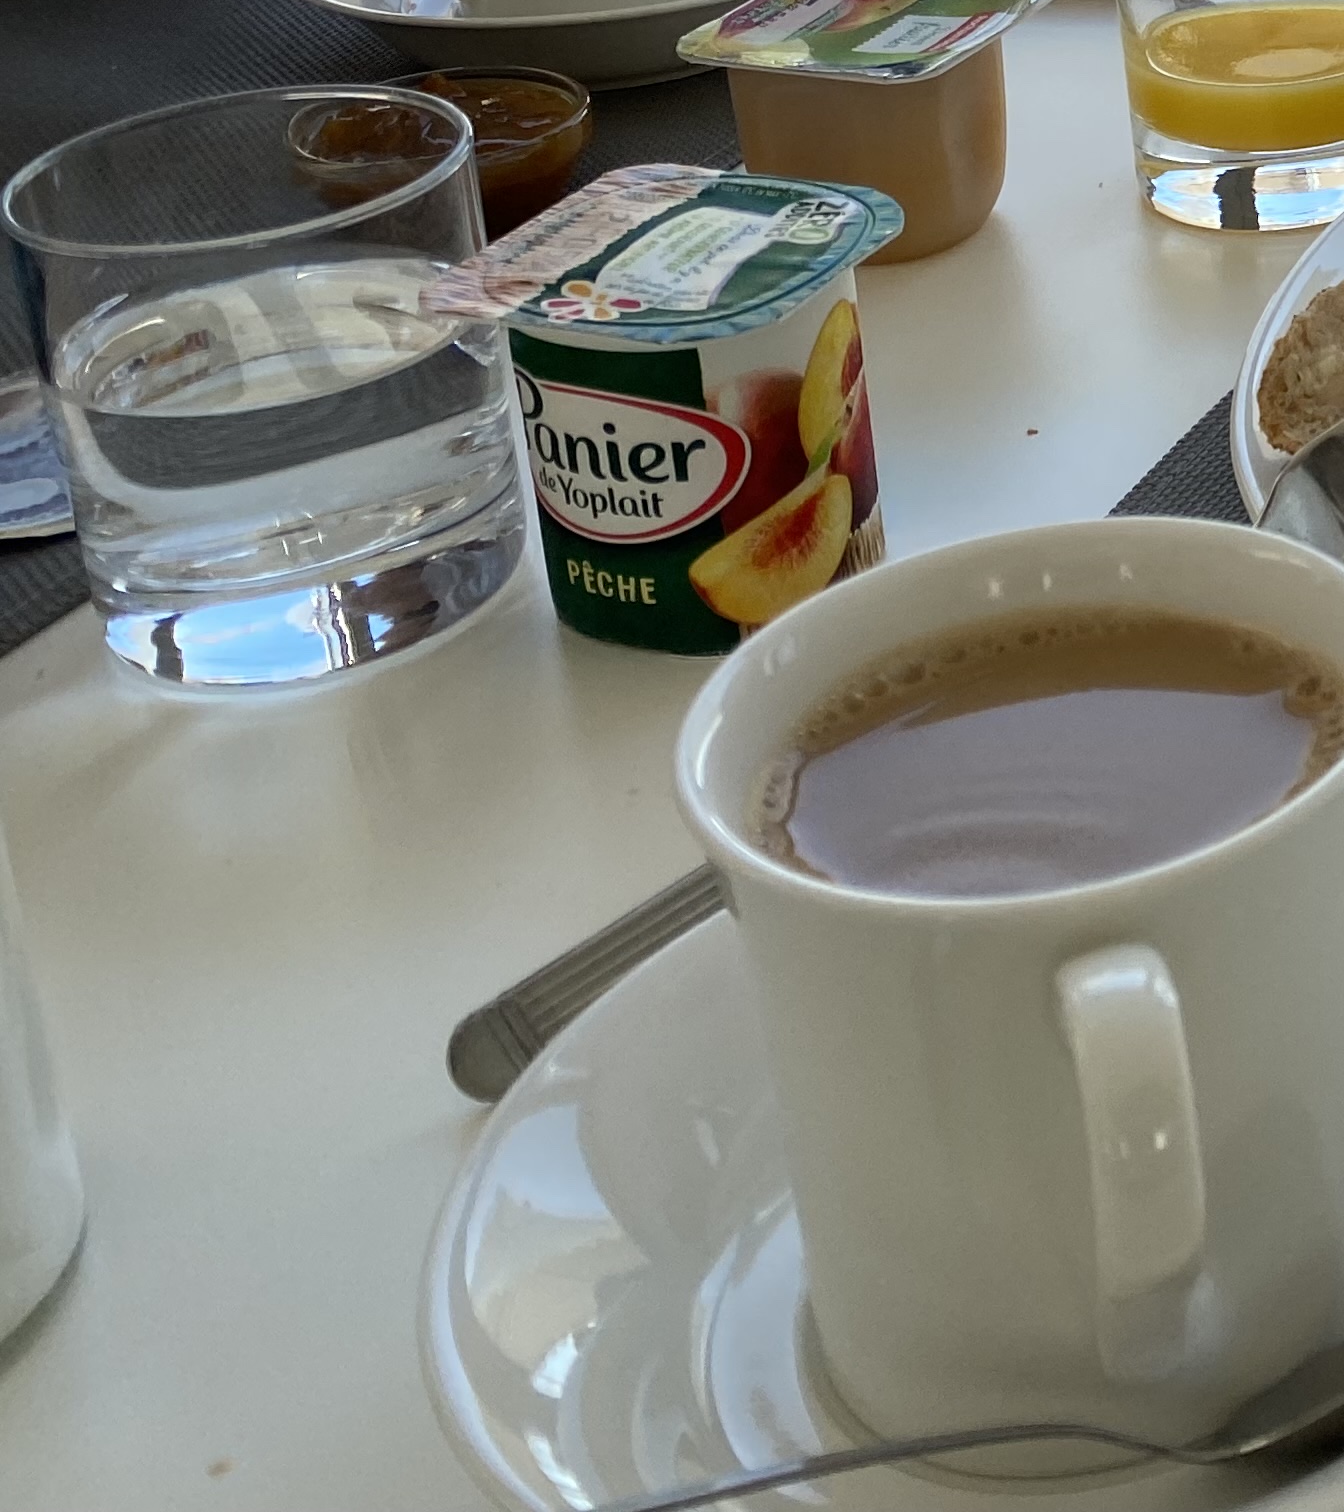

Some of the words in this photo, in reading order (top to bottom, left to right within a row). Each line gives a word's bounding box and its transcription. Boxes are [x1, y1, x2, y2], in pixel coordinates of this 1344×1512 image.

[513, 366, 707, 484] Panier
[539, 467, 557, 493] de
[557, 474, 665, 519] Yoplait
[566, 559, 658, 605] PÊCHE
